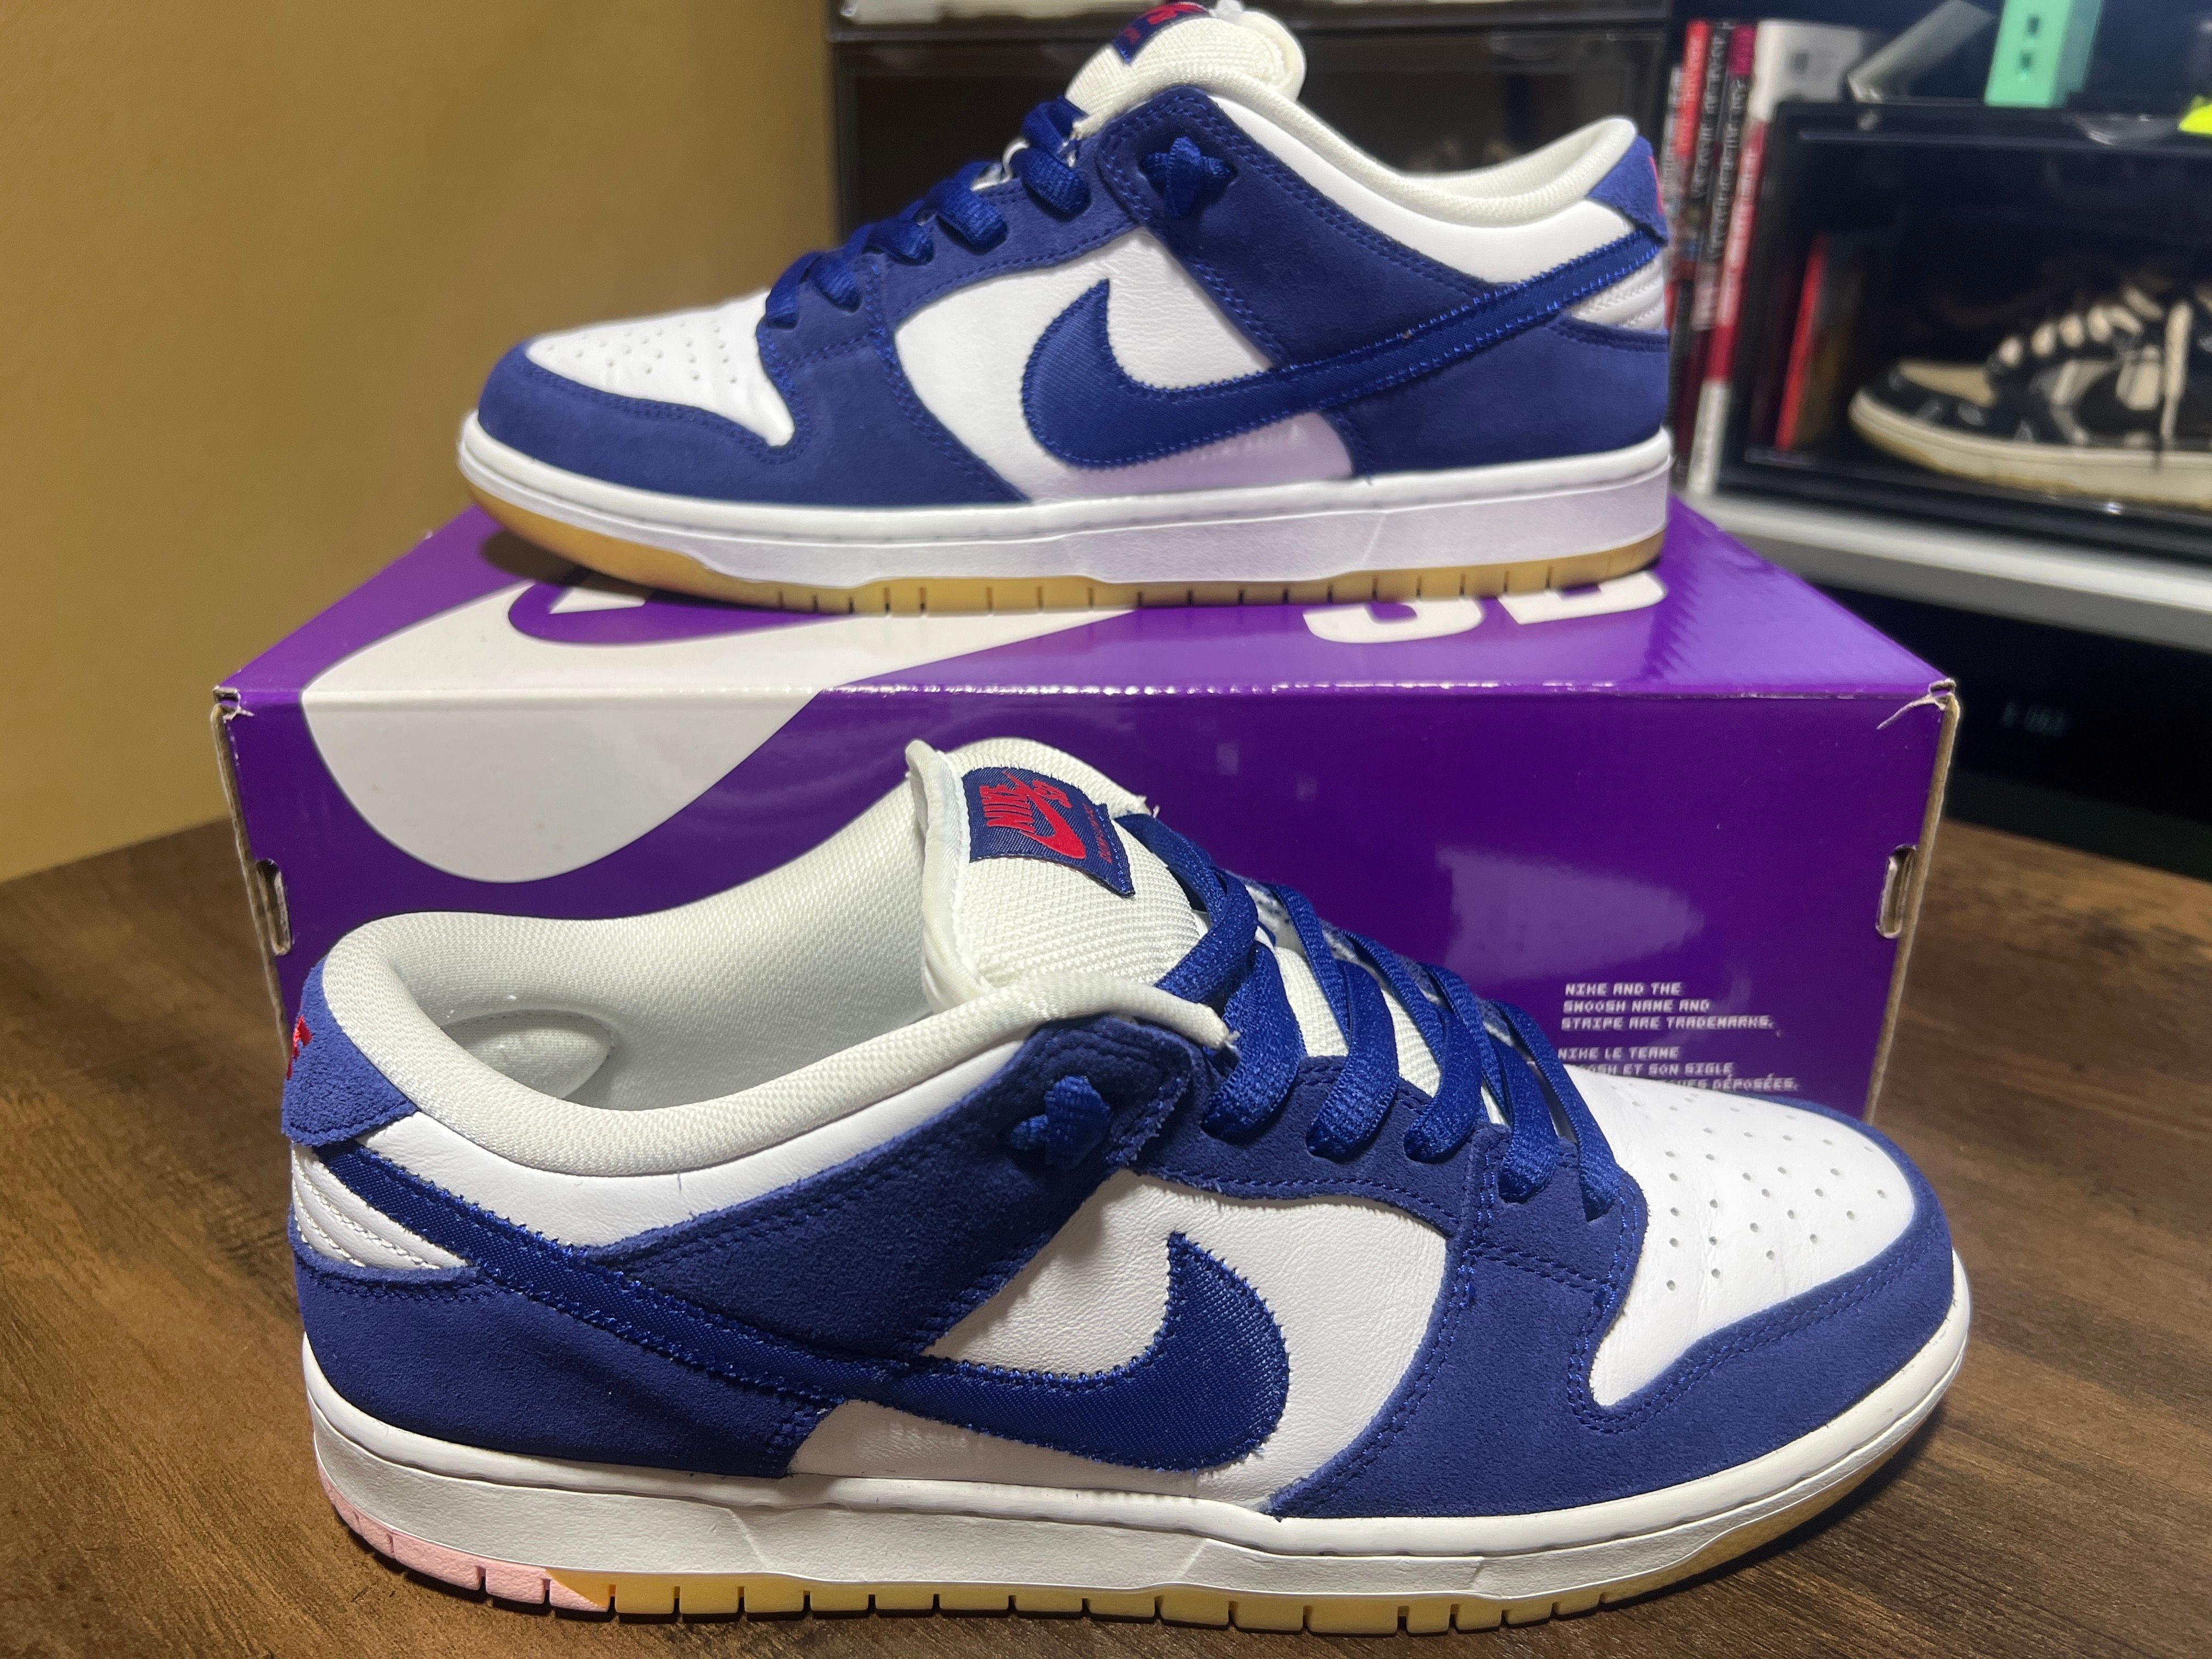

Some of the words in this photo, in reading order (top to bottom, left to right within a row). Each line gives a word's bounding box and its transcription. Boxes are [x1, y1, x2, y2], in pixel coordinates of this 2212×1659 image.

[1565, 983, 1607, 996] NIKE
[1613, 983, 1645, 996] AND
[1651, 982, 1681, 996] THE
[1564, 1000, 1626, 1013] SWOOSH
[1632, 1000, 1673, 1012] NAME
[1679, 999, 1710, 1012] AND
[1561, 1017, 1623, 1030] STRIPE
[1629, 1017, 1660, 1029] ARE
[1666, 1015, 1773, 1029] TRADEMARKS.
[1558, 1047, 1599, 1060] NIKE
[1605, 1047, 1623, 1060] LE
[1629, 1047, 1680, 1060] TERME
[1623, 1063, 1644, 1075] ET
[1649, 1063, 1679, 1076] SON
[1685, 1063, 1735, 1076] SIGLE
